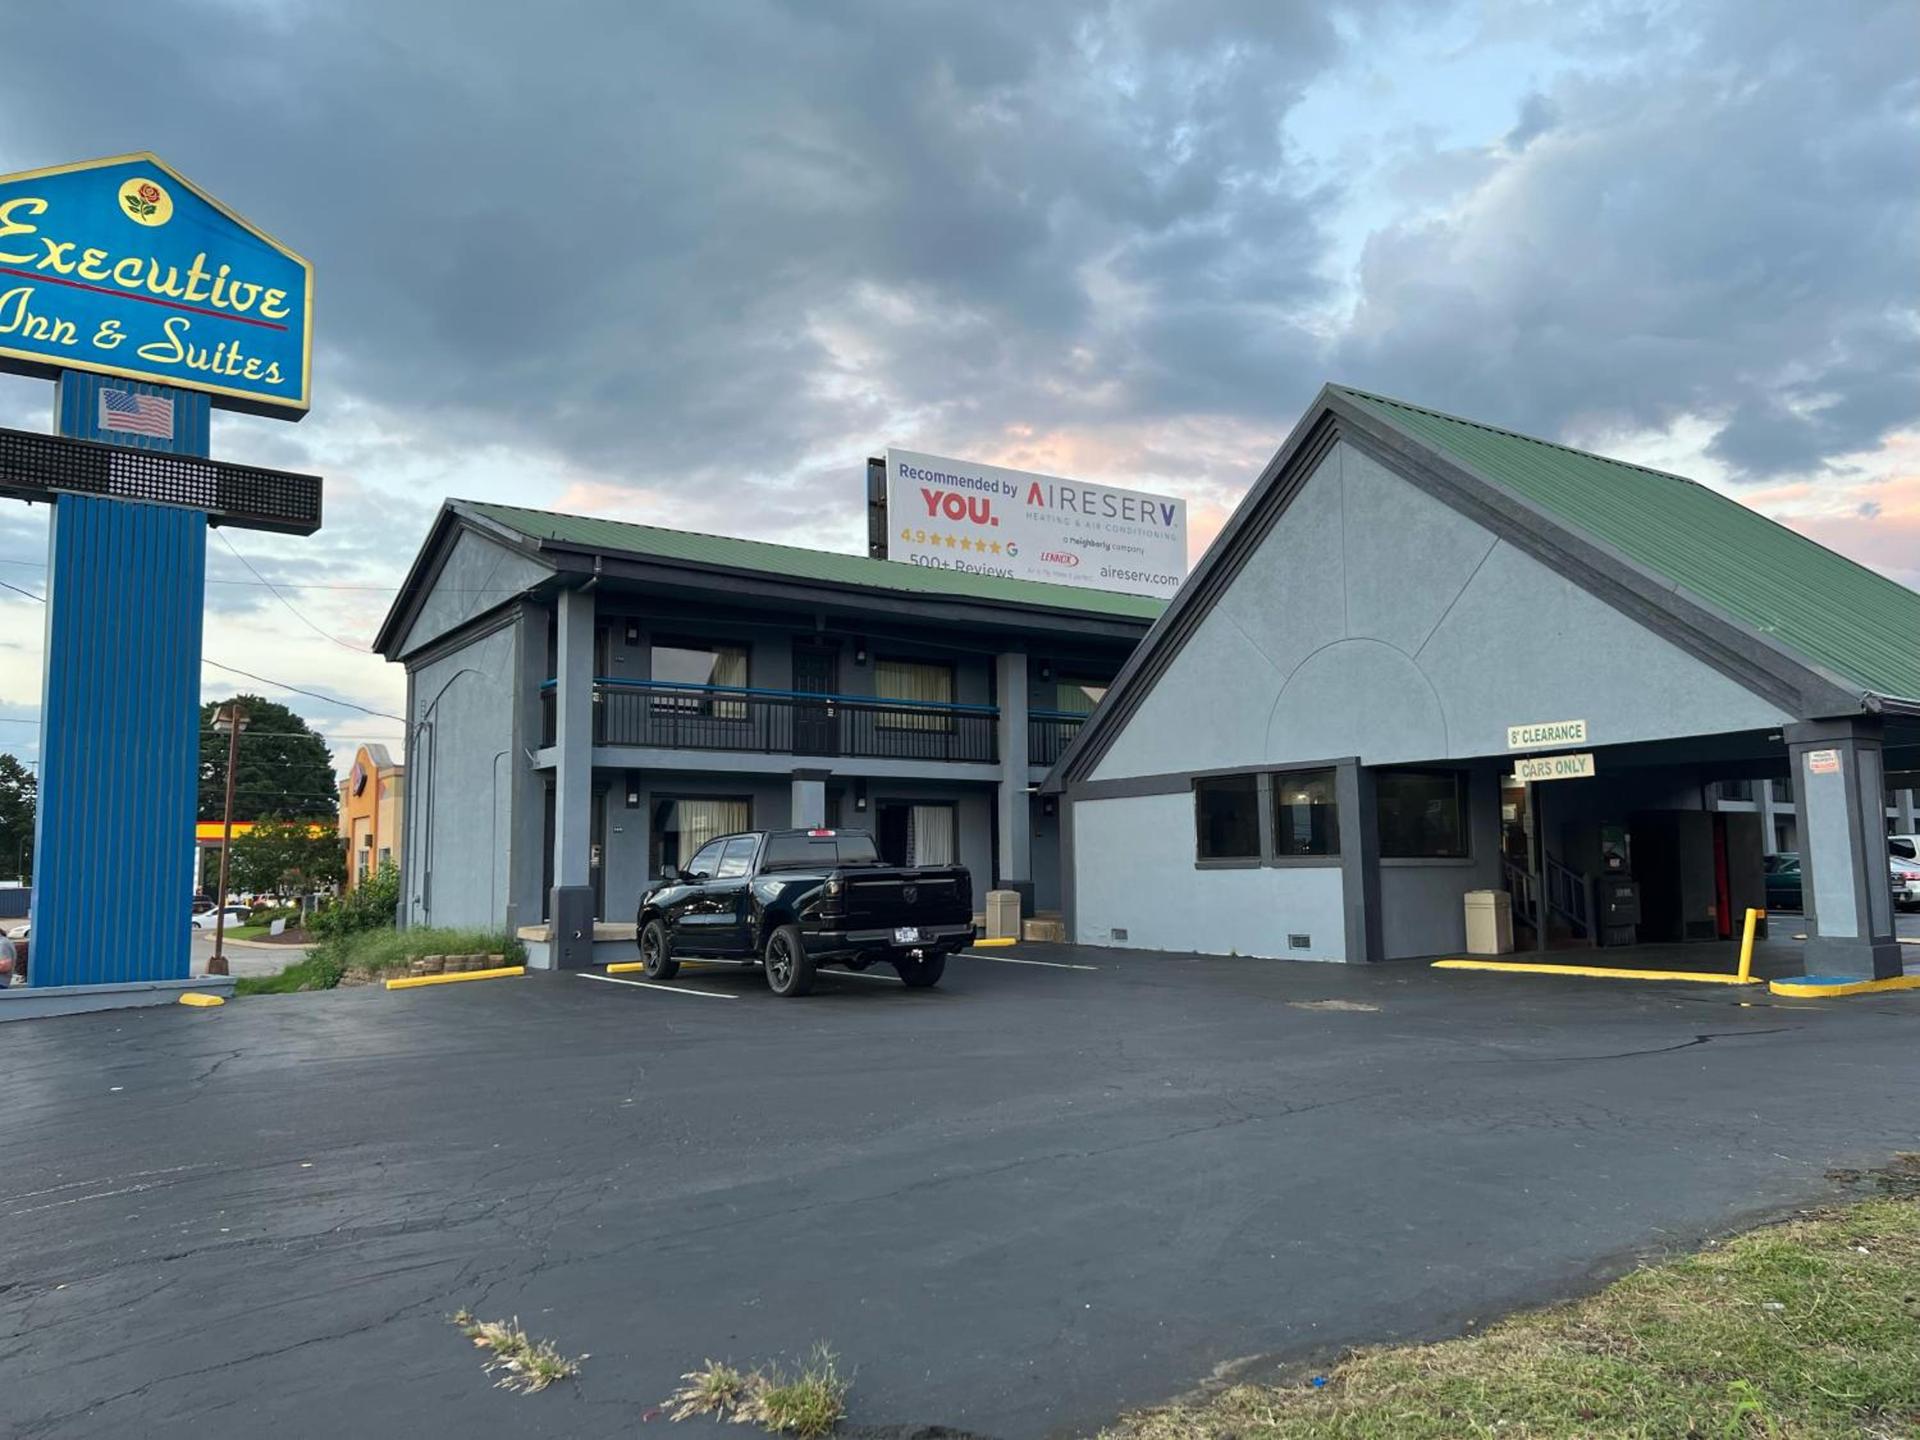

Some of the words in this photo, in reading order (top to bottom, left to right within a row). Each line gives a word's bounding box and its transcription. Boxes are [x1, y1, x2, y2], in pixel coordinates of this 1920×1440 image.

[0, 197, 290, 318] Executive
[0, 287, 79, 345] Inn
[93, 320, 127, 349] &
[138, 317, 286, 384] Suites
[899, 463, 999, 493] Recommended
[1003, 481, 1018, 499] by
[920, 488, 999, 527] YOU.
[1027, 482, 1176, 527] AIRESERV
[901, 528, 926, 544] 4.9
[1105, 524, 1177, 541] CONDITIONING
[910, 553, 950, 569] 500+
[955, 560, 1014, 578] Reviews
[1040, 551, 1074, 564] LENNOX
[1100, 565, 1180, 586] aireserv.com
[1522, 725, 1582, 743] CLEARANCE
[1522, 762, 1552, 777] CARS
[1556, 758, 1586, 773] ONLY
